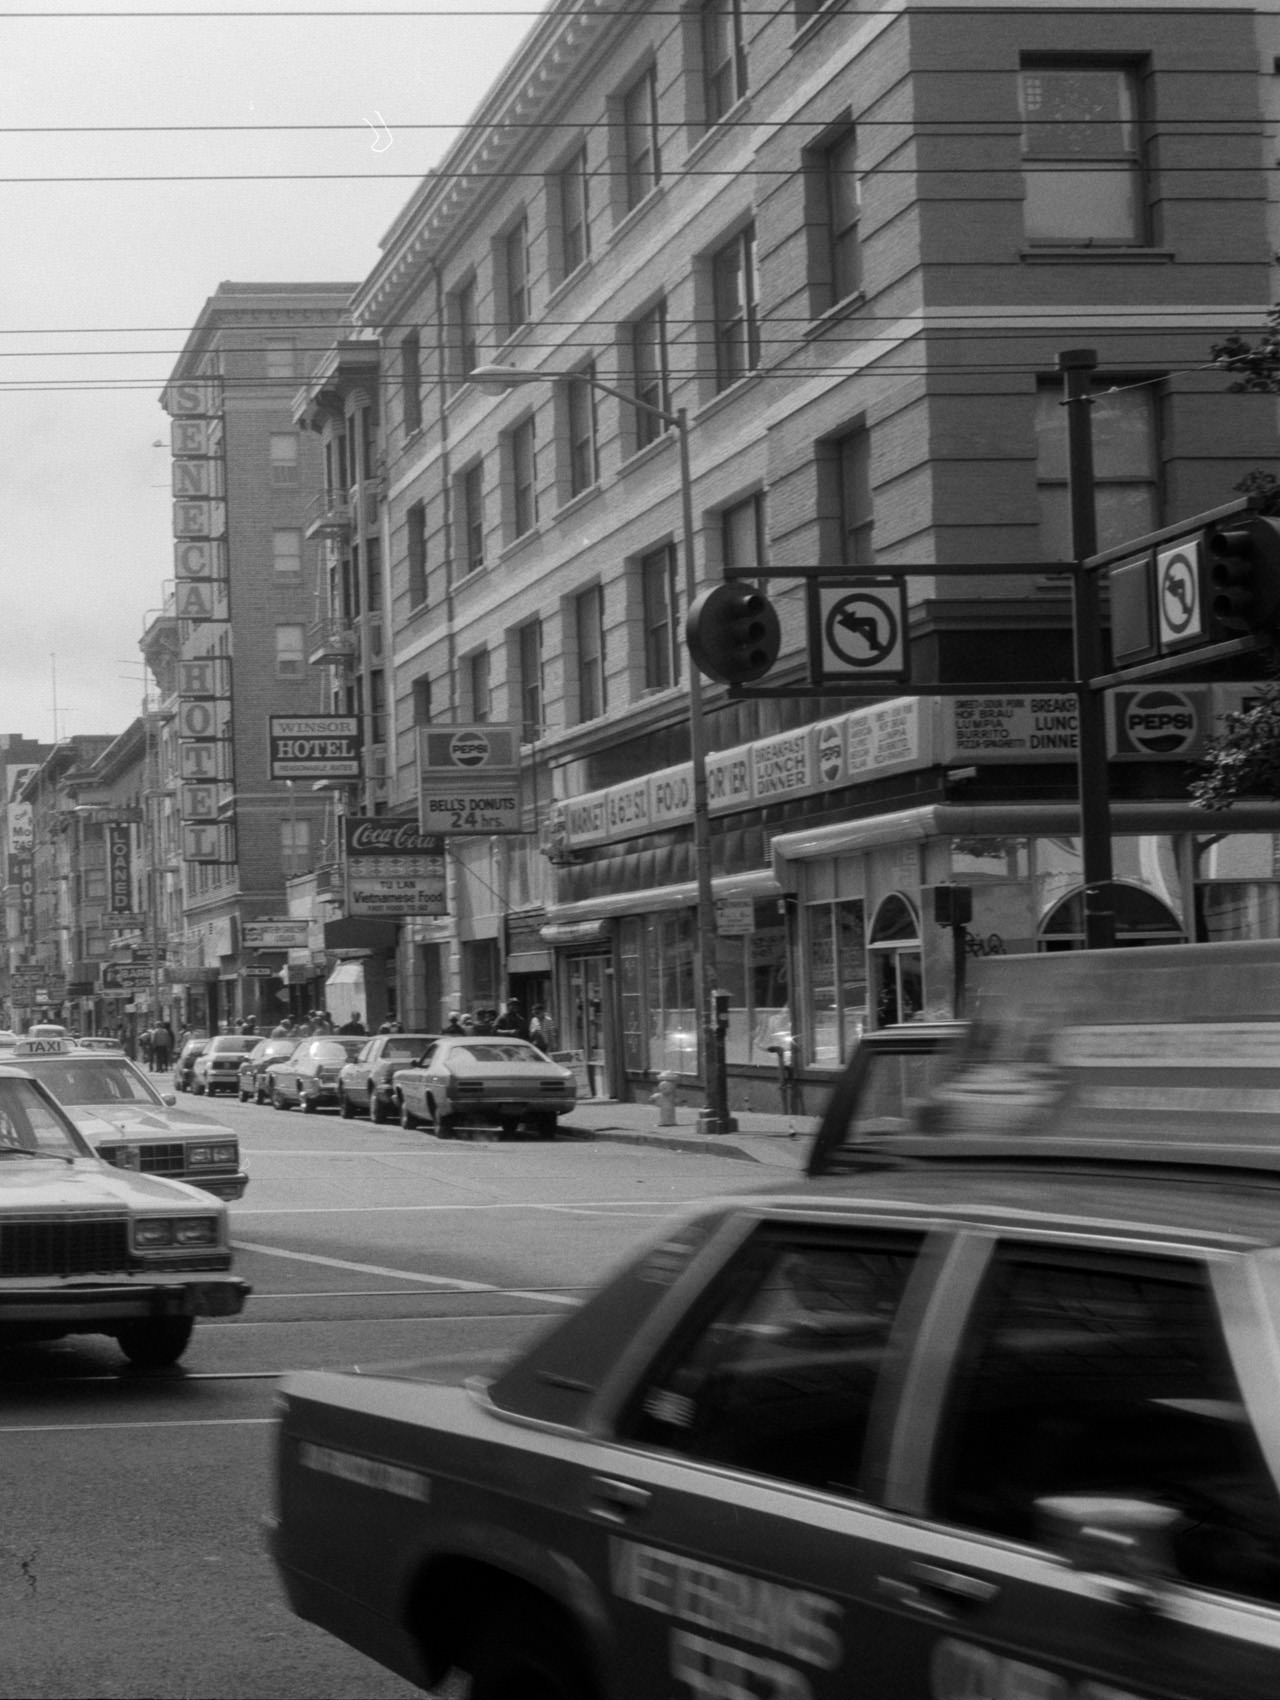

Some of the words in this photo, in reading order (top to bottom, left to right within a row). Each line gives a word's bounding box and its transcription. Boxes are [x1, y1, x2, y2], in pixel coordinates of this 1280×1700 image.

[177, 382, 208, 616] SENECA
[278, 722, 354, 733] WINSOR
[1035, 716, 1078, 731] LUNC
[1129, 713, 1193, 730] PEPSI
[956, 729, 1009, 740] BURRITO
[1029, 734, 1078, 749] DINNE
[276, 740, 356, 758] HOTEL
[451, 743, 489, 754] PEPSI
[755, 735, 806, 765] BREAKFAST
[182, 663, 216, 858] HOTEL
[756, 753, 806, 780] LUNCH
[757, 770, 806, 795] DINNER
[429, 798, 466, 812] BELL'S
[470, 797, 516, 811] DONUTS
[353, 822, 437, 850] Coca-Cola
[113, 831, 129, 907] LOANED
[353, 890, 417, 904] Vietnamese
[418, 890, 442, 903] Food
[26, 1041, 62, 1053] TAXI
